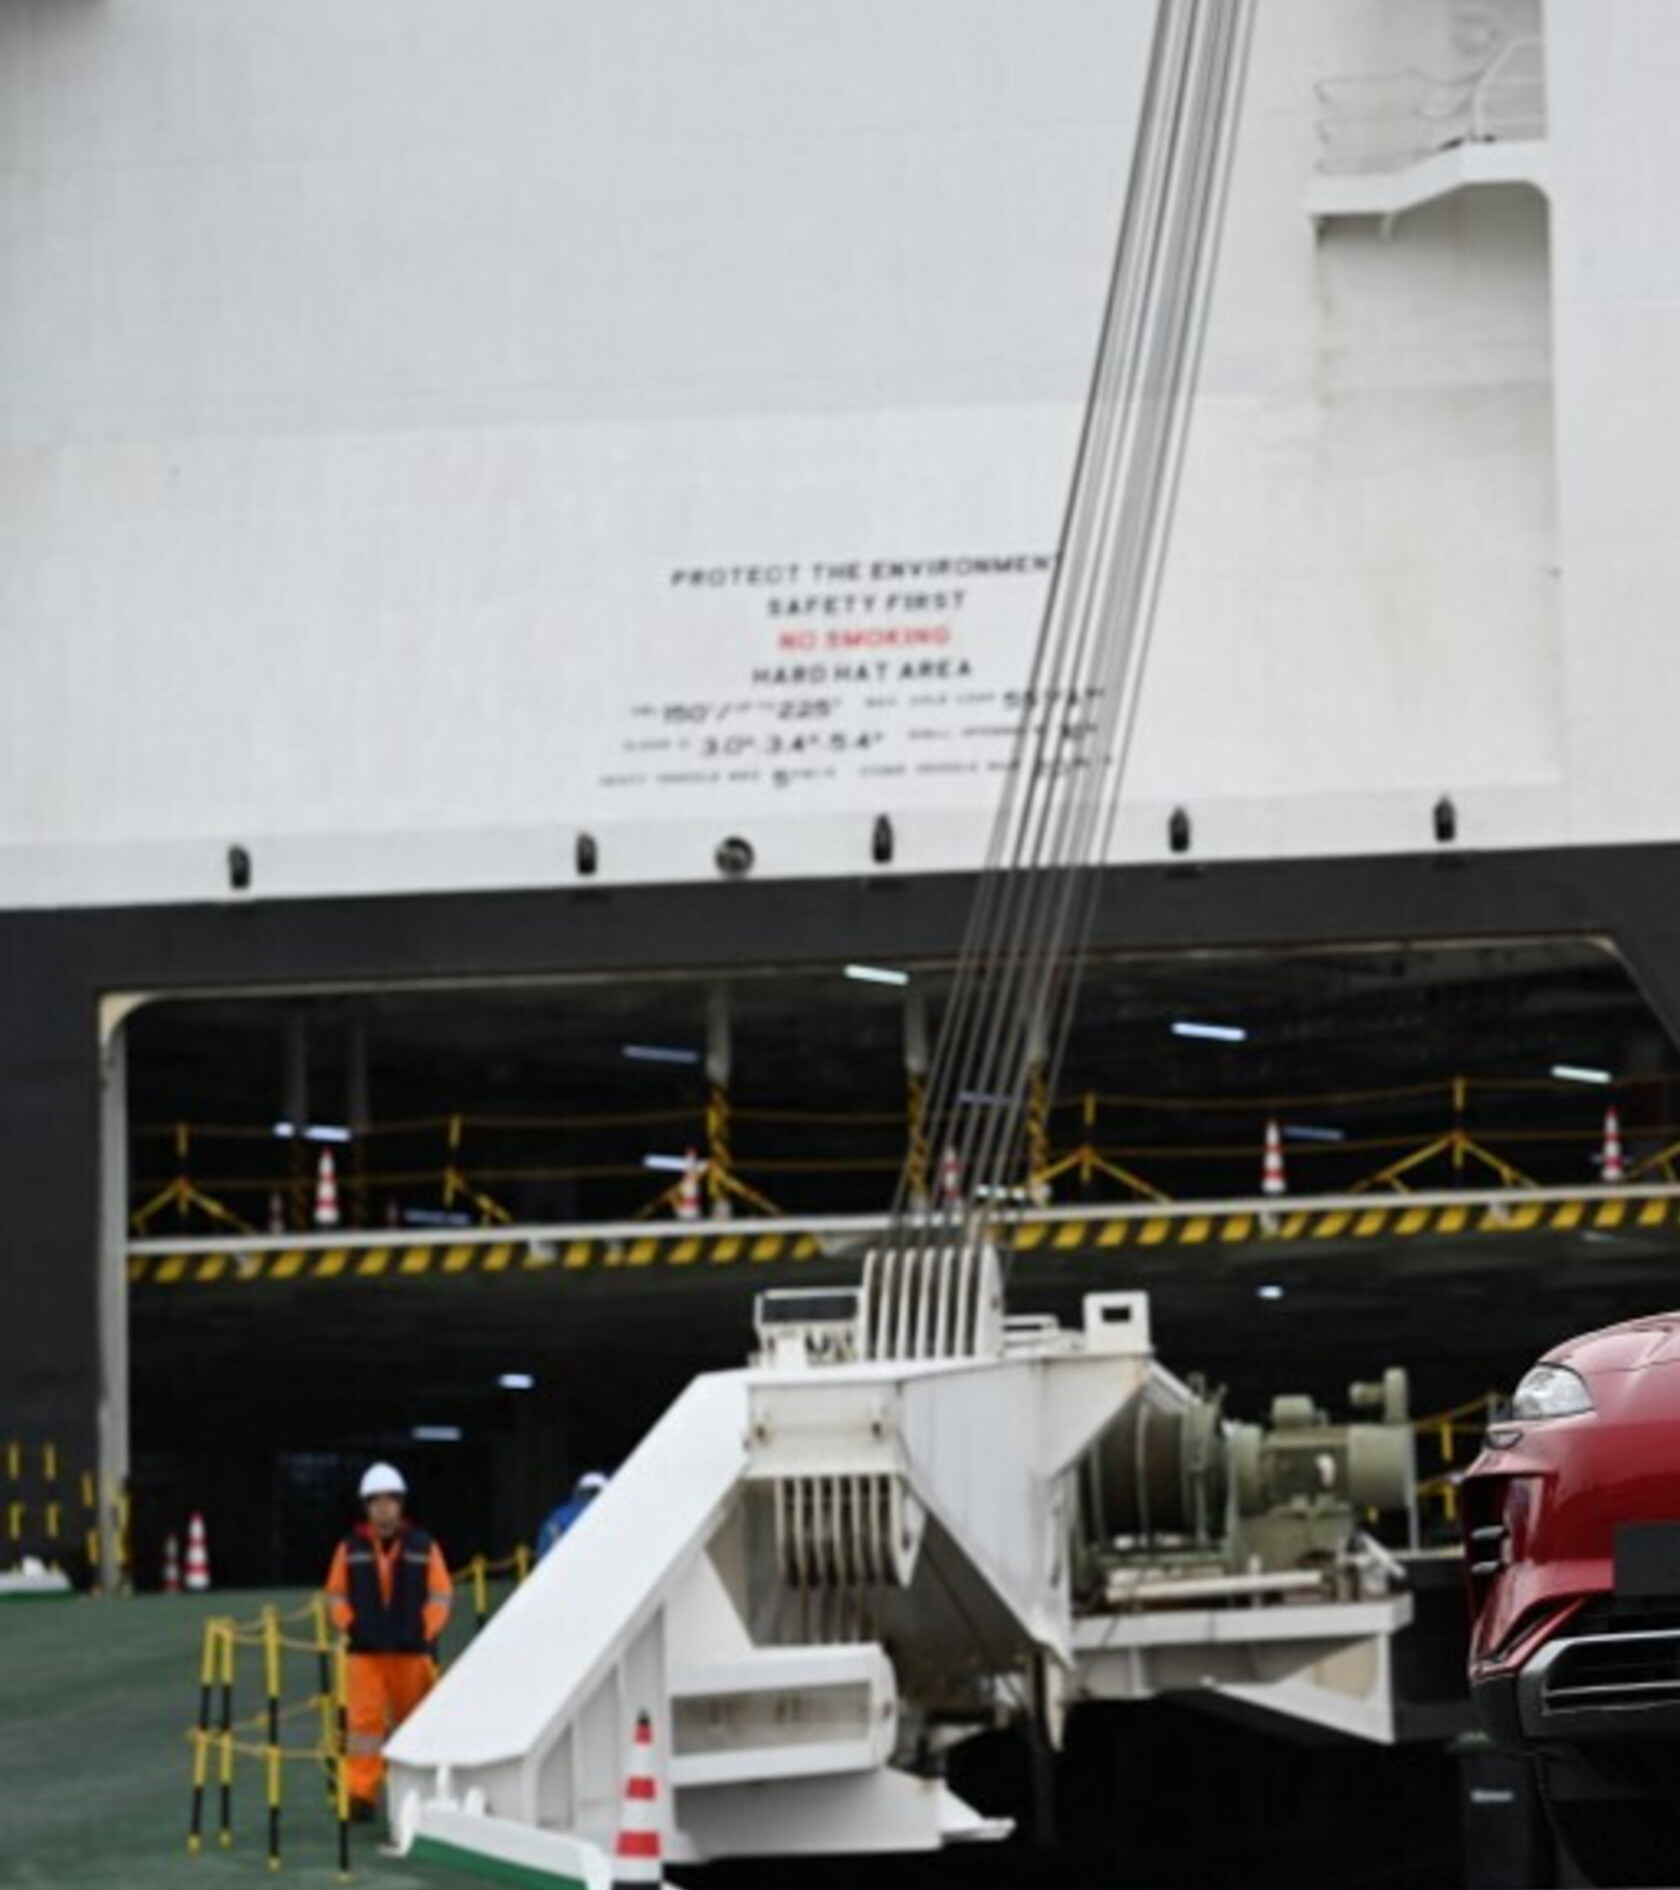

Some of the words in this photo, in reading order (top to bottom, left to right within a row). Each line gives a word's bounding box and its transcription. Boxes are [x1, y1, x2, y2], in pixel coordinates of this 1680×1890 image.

[671, 564, 799, 587] PROTECT
[813, 562, 860, 582] THE
[767, 595, 875, 617] SAFETY
[886, 590, 965, 611] FIRST
[778, 630, 817, 651] NO
[826, 625, 950, 649] SMOKING
[752, 664, 828, 685] HARD
[833, 661, 888, 683] HAT
[899, 658, 972, 680] AREA
